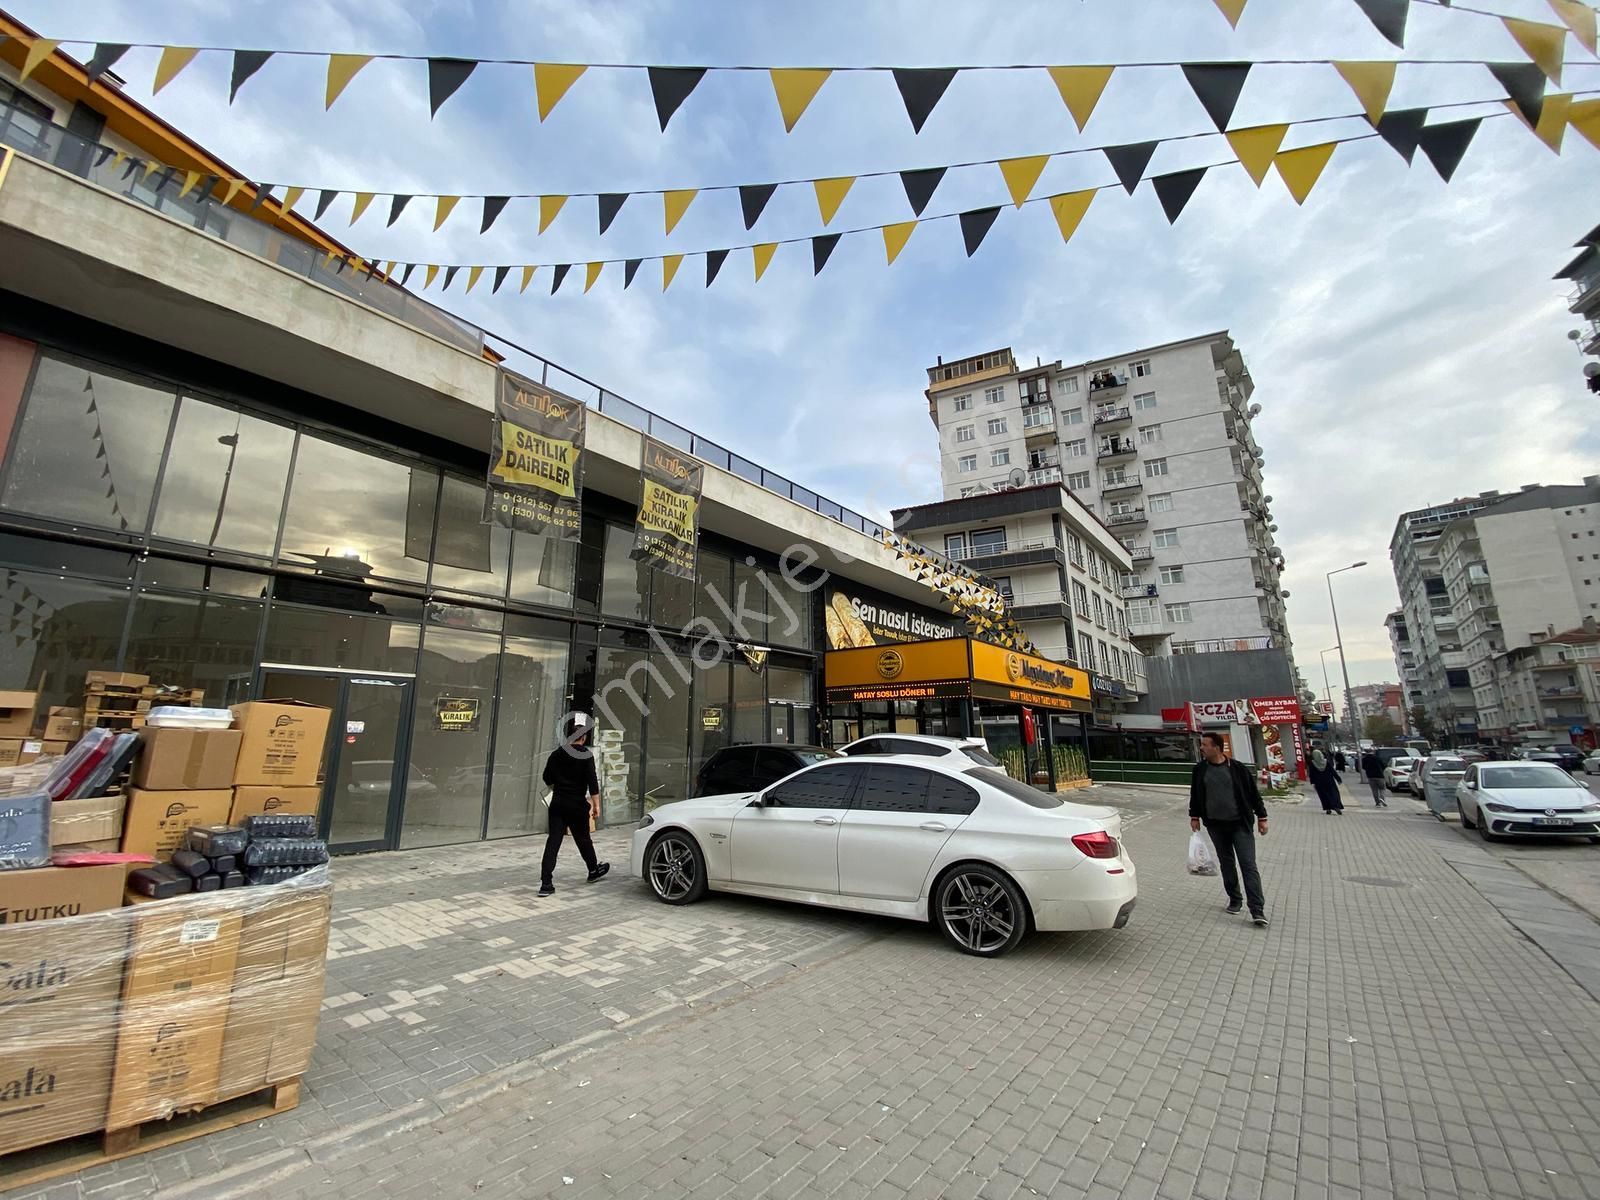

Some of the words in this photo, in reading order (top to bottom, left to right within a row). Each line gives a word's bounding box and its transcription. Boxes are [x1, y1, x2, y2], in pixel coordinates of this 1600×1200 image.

[516, 431, 568, 464] SATILIK
[512, 494, 537, 508] (312)
[538, 501, 553, 512] 557
[653, 487, 688, 511] SATILIK
[511, 506, 535, 520] (530)
[851, 597, 877, 624] Sen
[878, 608, 909, 632] nasıl
[854, 691, 875, 700] HATAY
[876, 690, 899, 698] SOSLU
[900, 688, 927, 697] DÖNER
[12, 903, 81, 923] TUTKU
